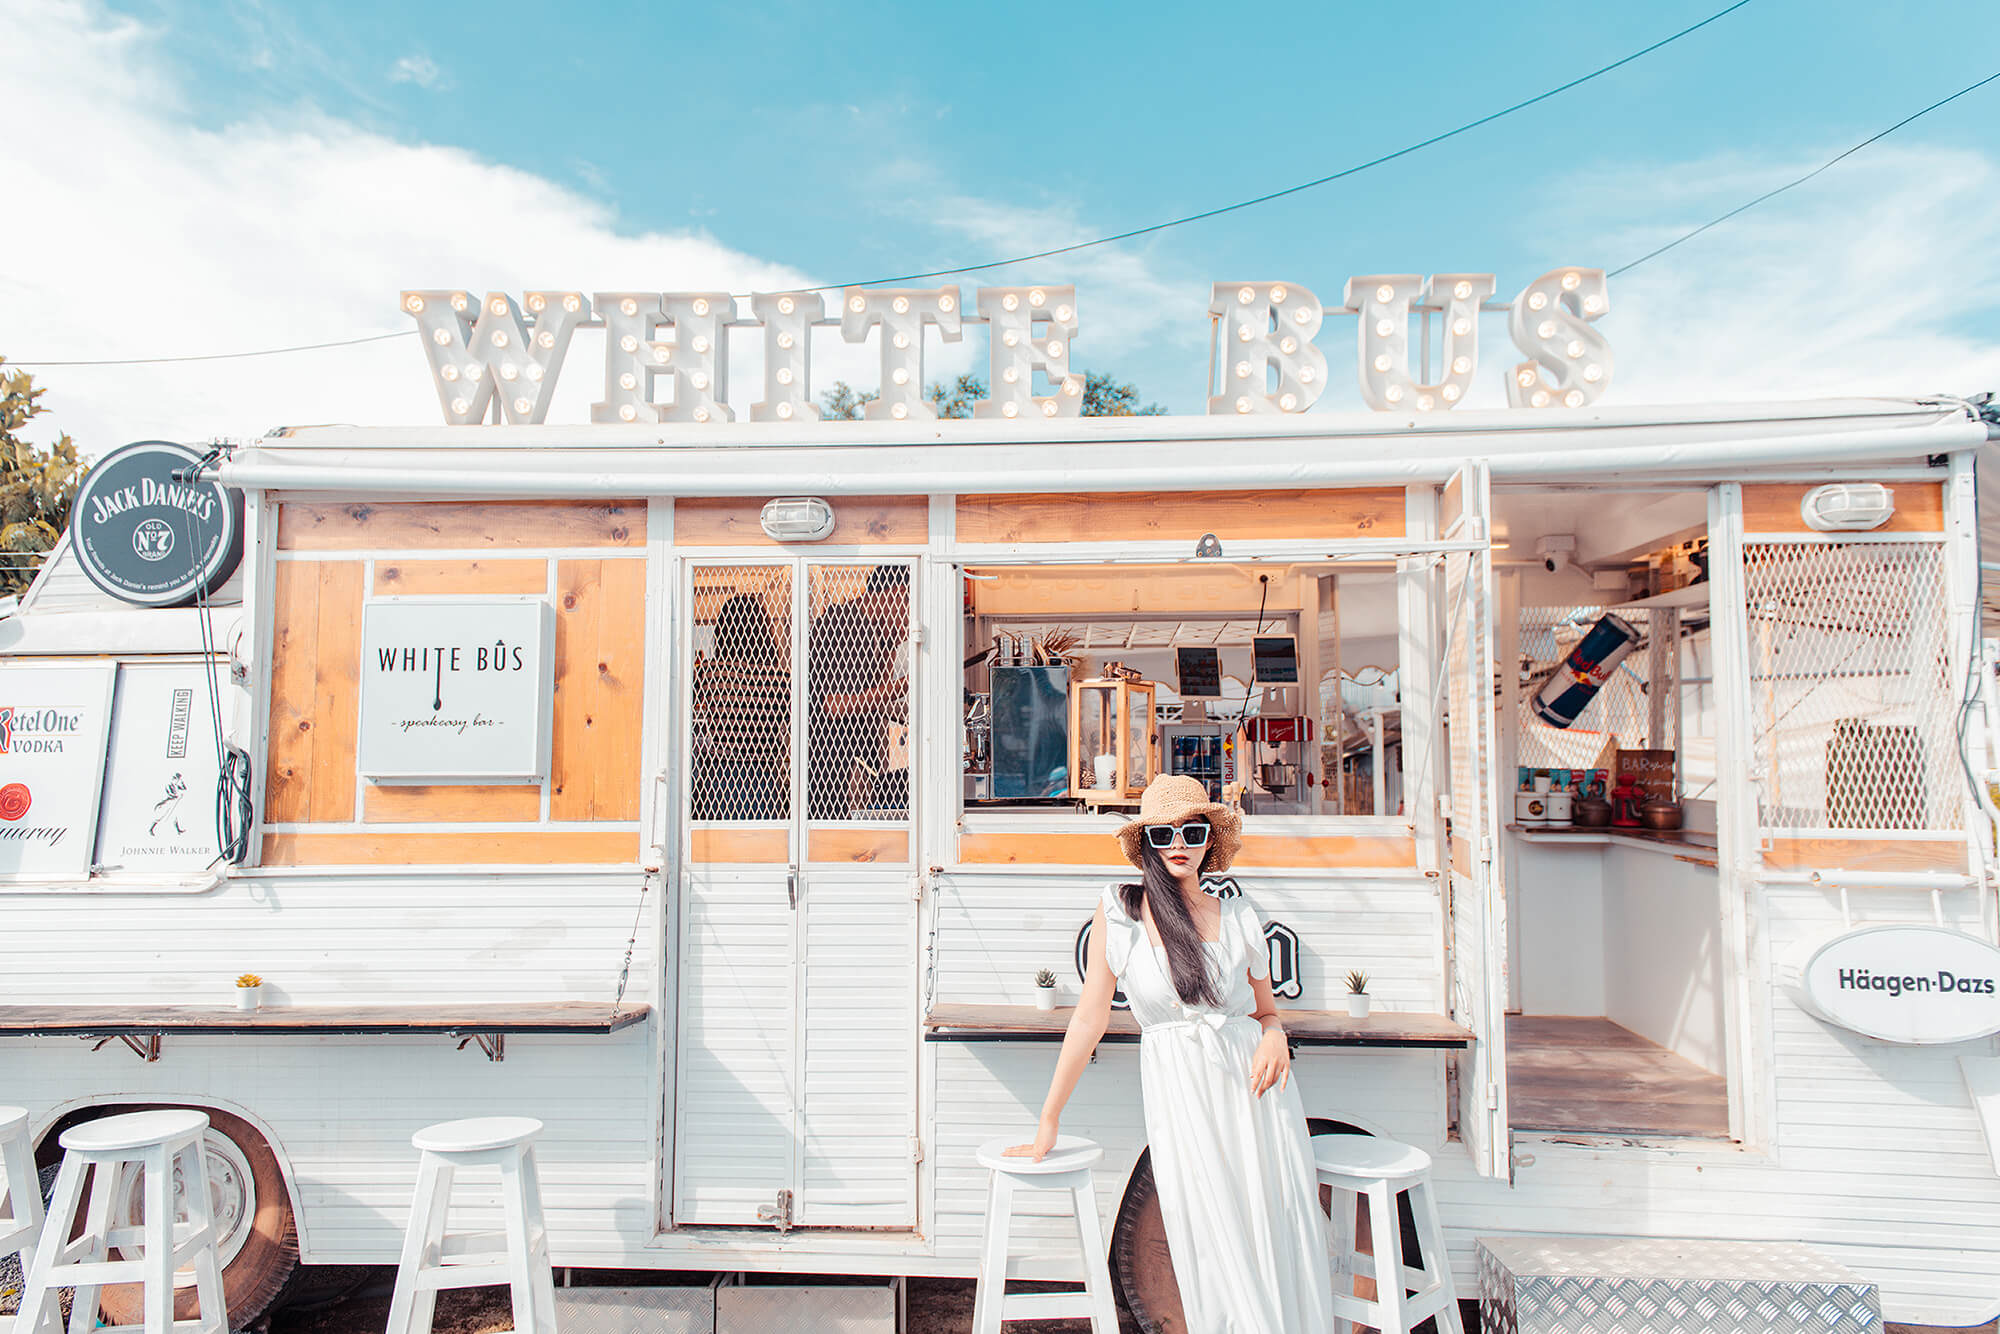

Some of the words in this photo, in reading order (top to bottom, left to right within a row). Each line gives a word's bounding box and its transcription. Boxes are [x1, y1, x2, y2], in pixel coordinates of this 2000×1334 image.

[400, 286, 1084, 425] WHITE
[1208, 266, 1614, 415] BUS
[92, 485, 141, 524] JACK
[145, 522, 162, 530] OLD
[378, 647, 461, 711] WHITE
[43, 709, 79, 732] One
[172, 691, 190, 732] WALKING
[400, 714, 469, 735] speakeasy
[473, 713, 495, 727] bar
[13, 740, 63, 753] VODKA
[170, 734, 185, 756] KEEP
[1622, 757, 1648, 772] BAR
[120, 846, 166, 857] JOHNNIE
[169, 845, 212, 856] WALKER
